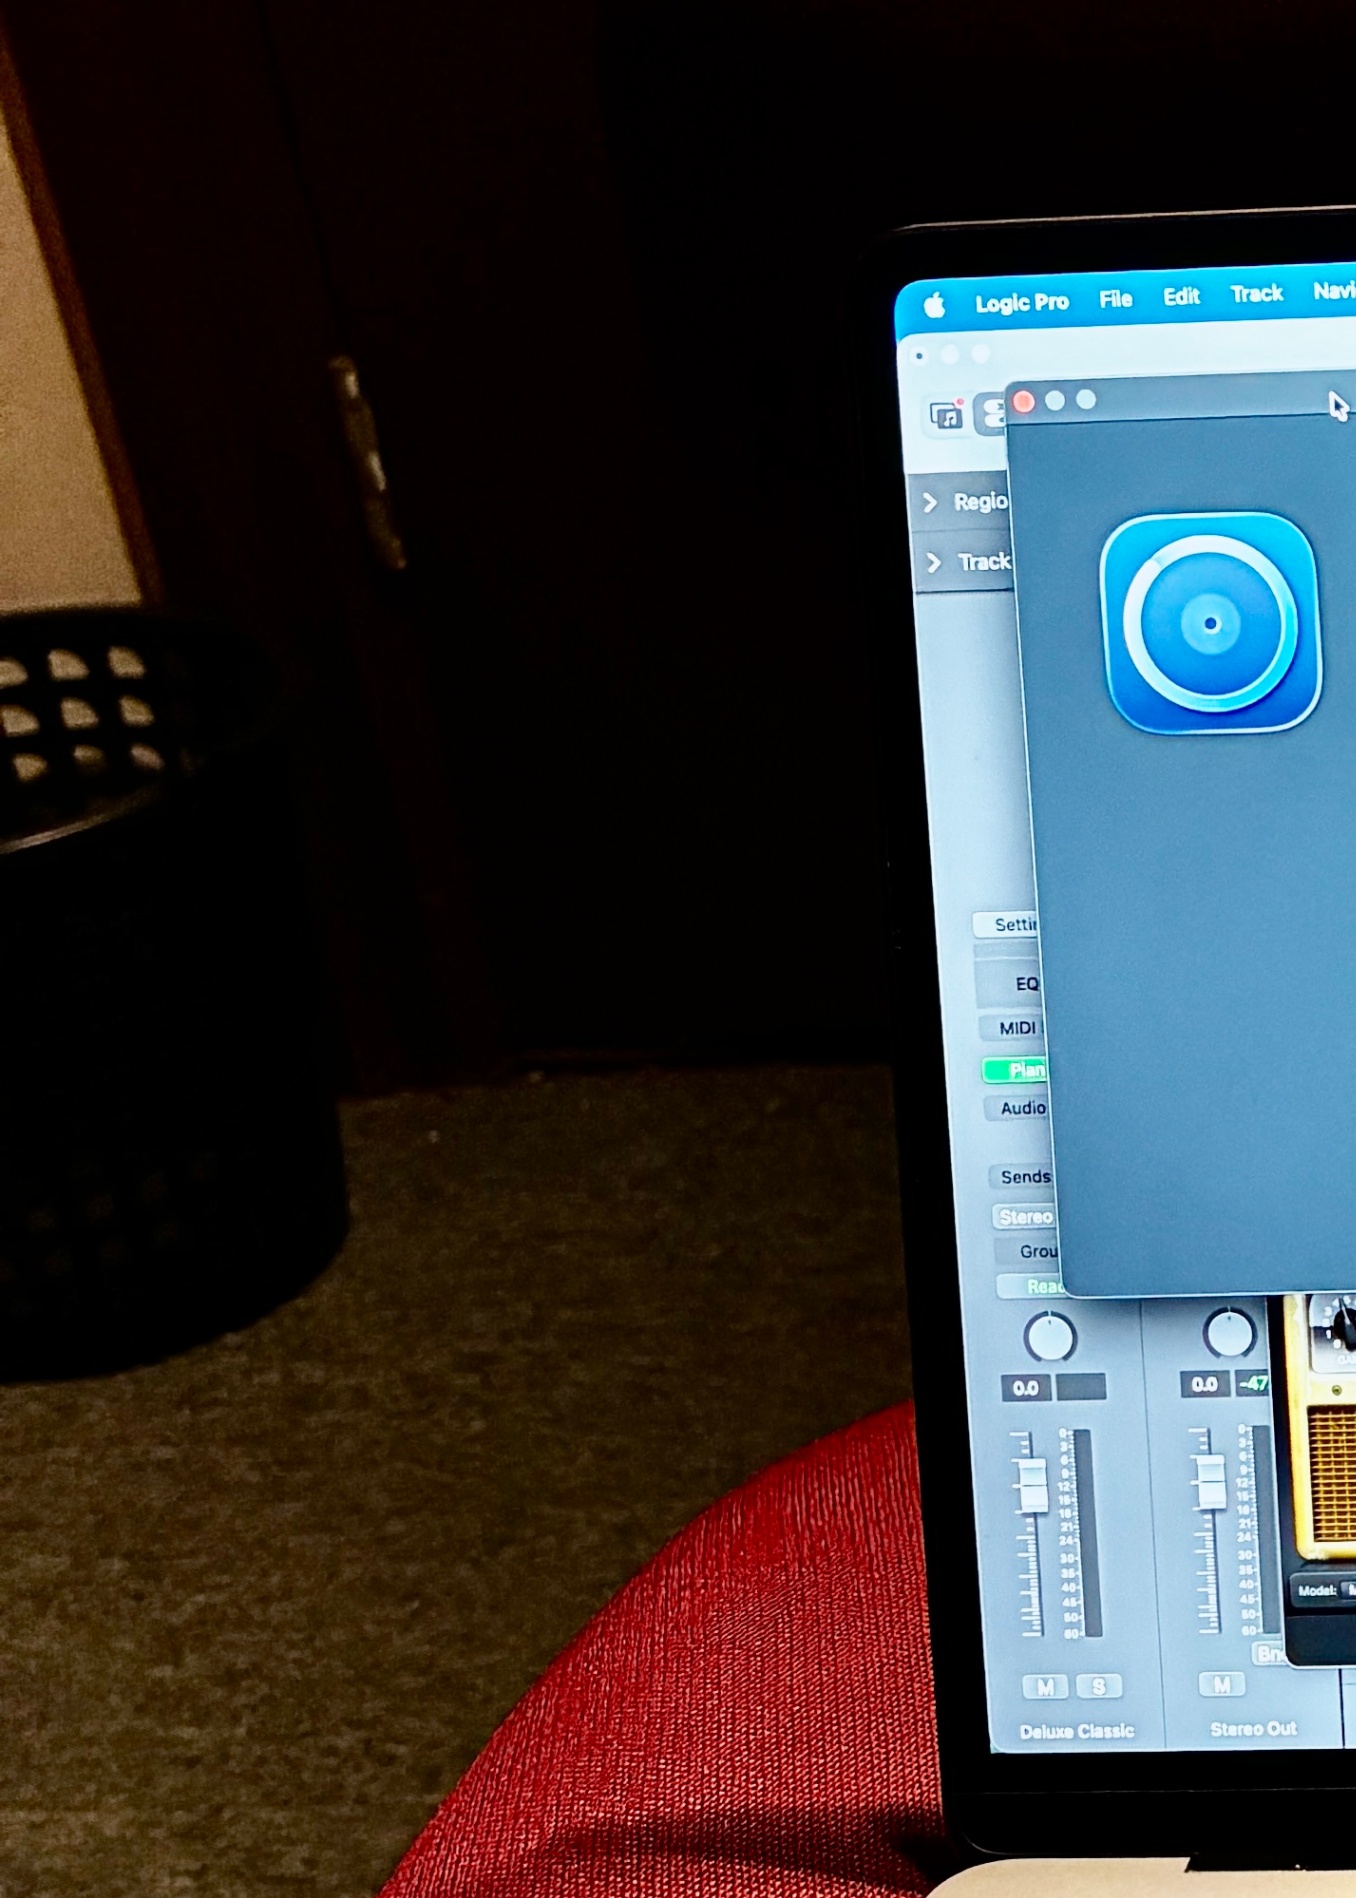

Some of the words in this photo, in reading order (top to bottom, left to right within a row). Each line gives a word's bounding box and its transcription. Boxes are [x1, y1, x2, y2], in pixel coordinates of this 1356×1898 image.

[976, 294, 1030, 316] Logic
[1036, 293, 1070, 312] Pro
[1100, 290, 1133, 308] File
[1164, 286, 1201, 306] Edit
[1231, 283, 1284, 303] Track
[1016, 977, 1041, 992] EQ
[1000, 1020, 1036, 1036] MIDI
[1001, 1099, 1047, 1116] Audio
[1001, 1170, 1052, 1185] Sends
